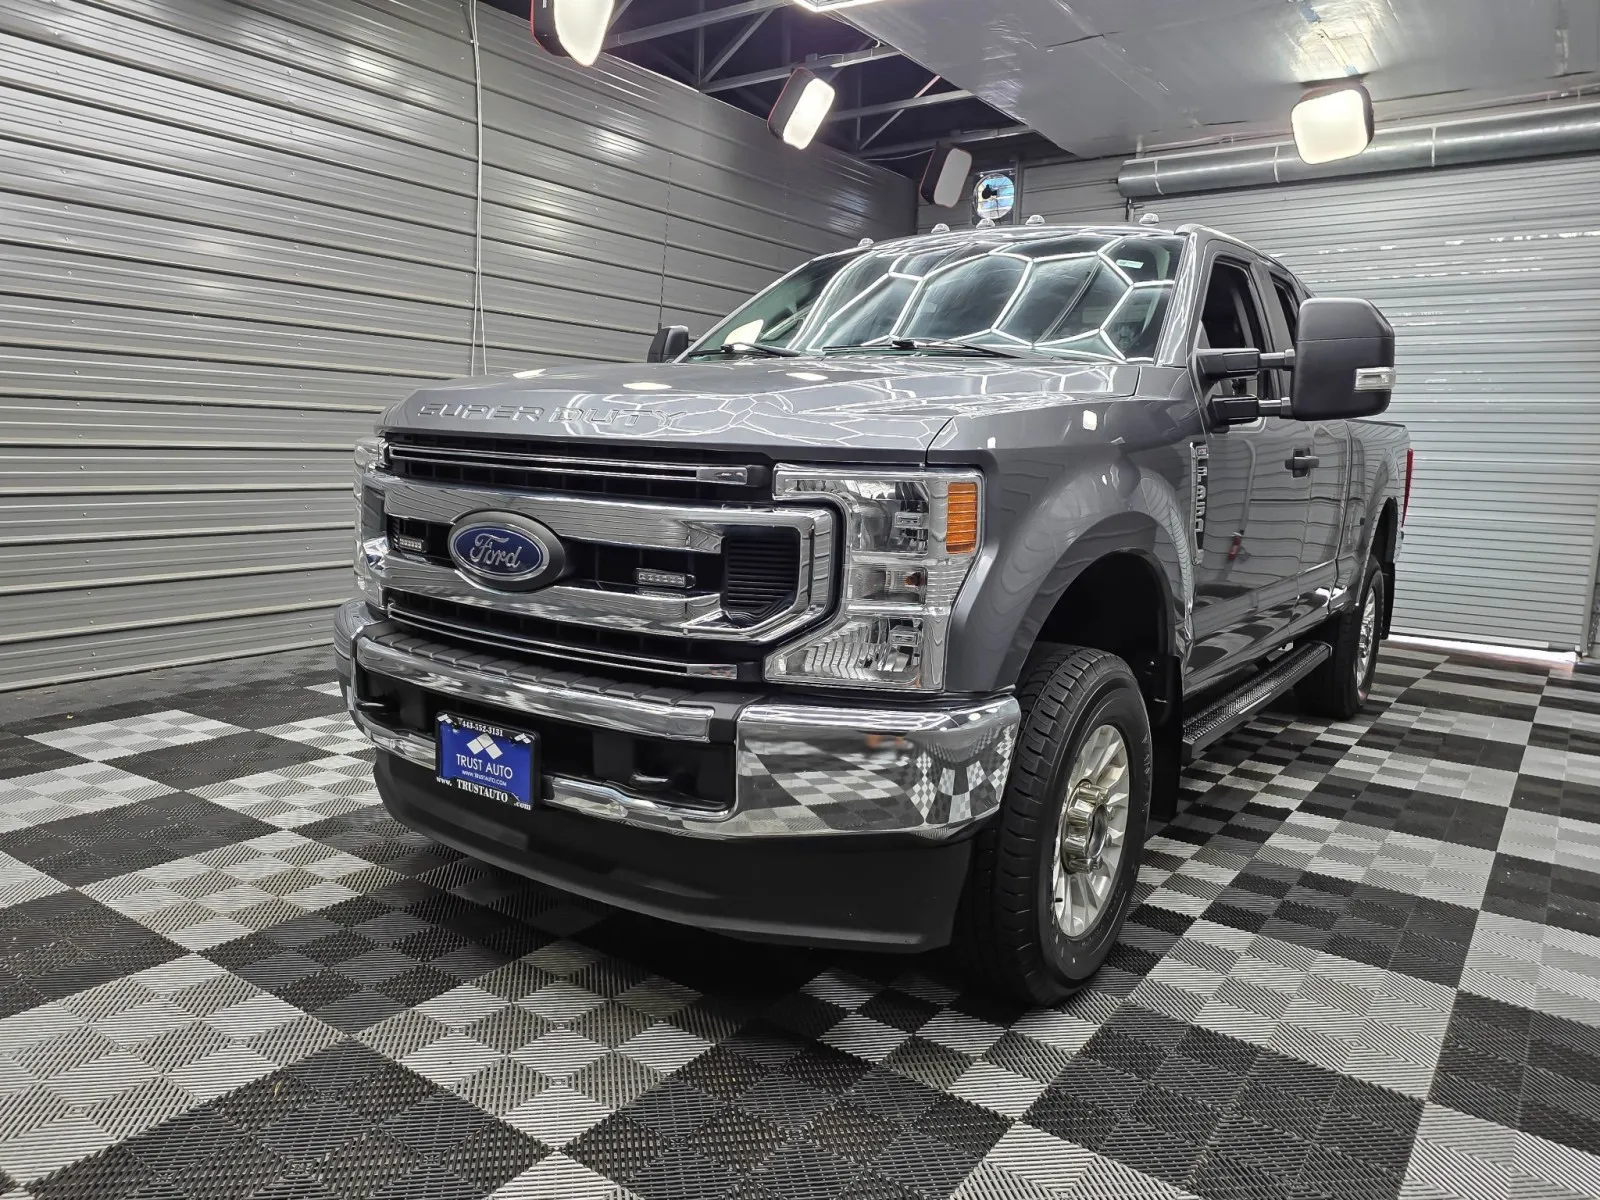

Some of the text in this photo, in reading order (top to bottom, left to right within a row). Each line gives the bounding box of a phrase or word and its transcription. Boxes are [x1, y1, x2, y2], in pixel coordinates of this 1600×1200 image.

[417, 403, 687, 427] SUPER DUTY
[469, 533, 523, 568] Ford
[456, 753, 514, 780] TRUST AUTO
[457, 778, 509, 803] TRUSTAUTO
